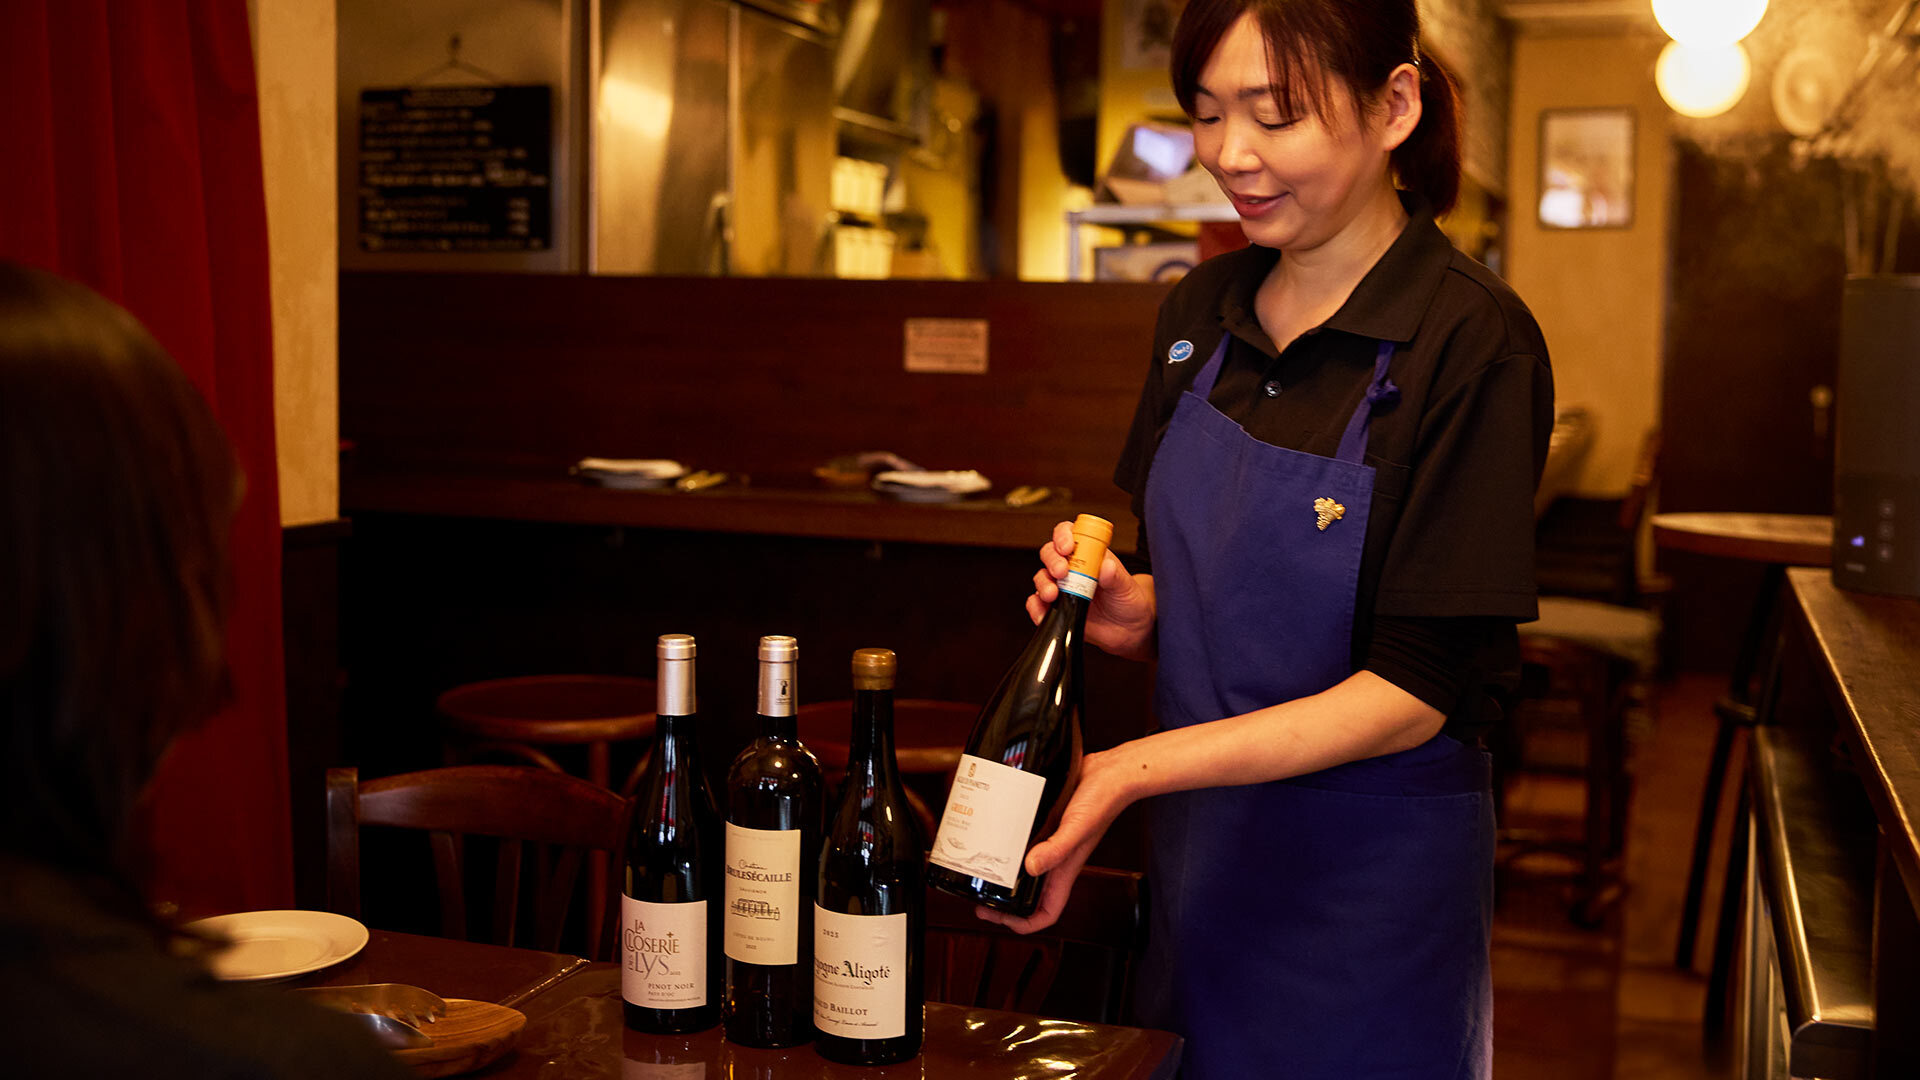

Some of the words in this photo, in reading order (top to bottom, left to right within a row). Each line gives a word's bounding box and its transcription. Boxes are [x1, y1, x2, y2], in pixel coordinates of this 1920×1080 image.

[634, 919, 646, 934] LA
[624, 928, 680, 955] CLOSERIE
[842, 960, 891, 986] Aligoté
[647, 982, 671, 990] PINOT
[674, 982, 695, 990] NOIR
[830, 1002, 868, 1016] BAILLOT
